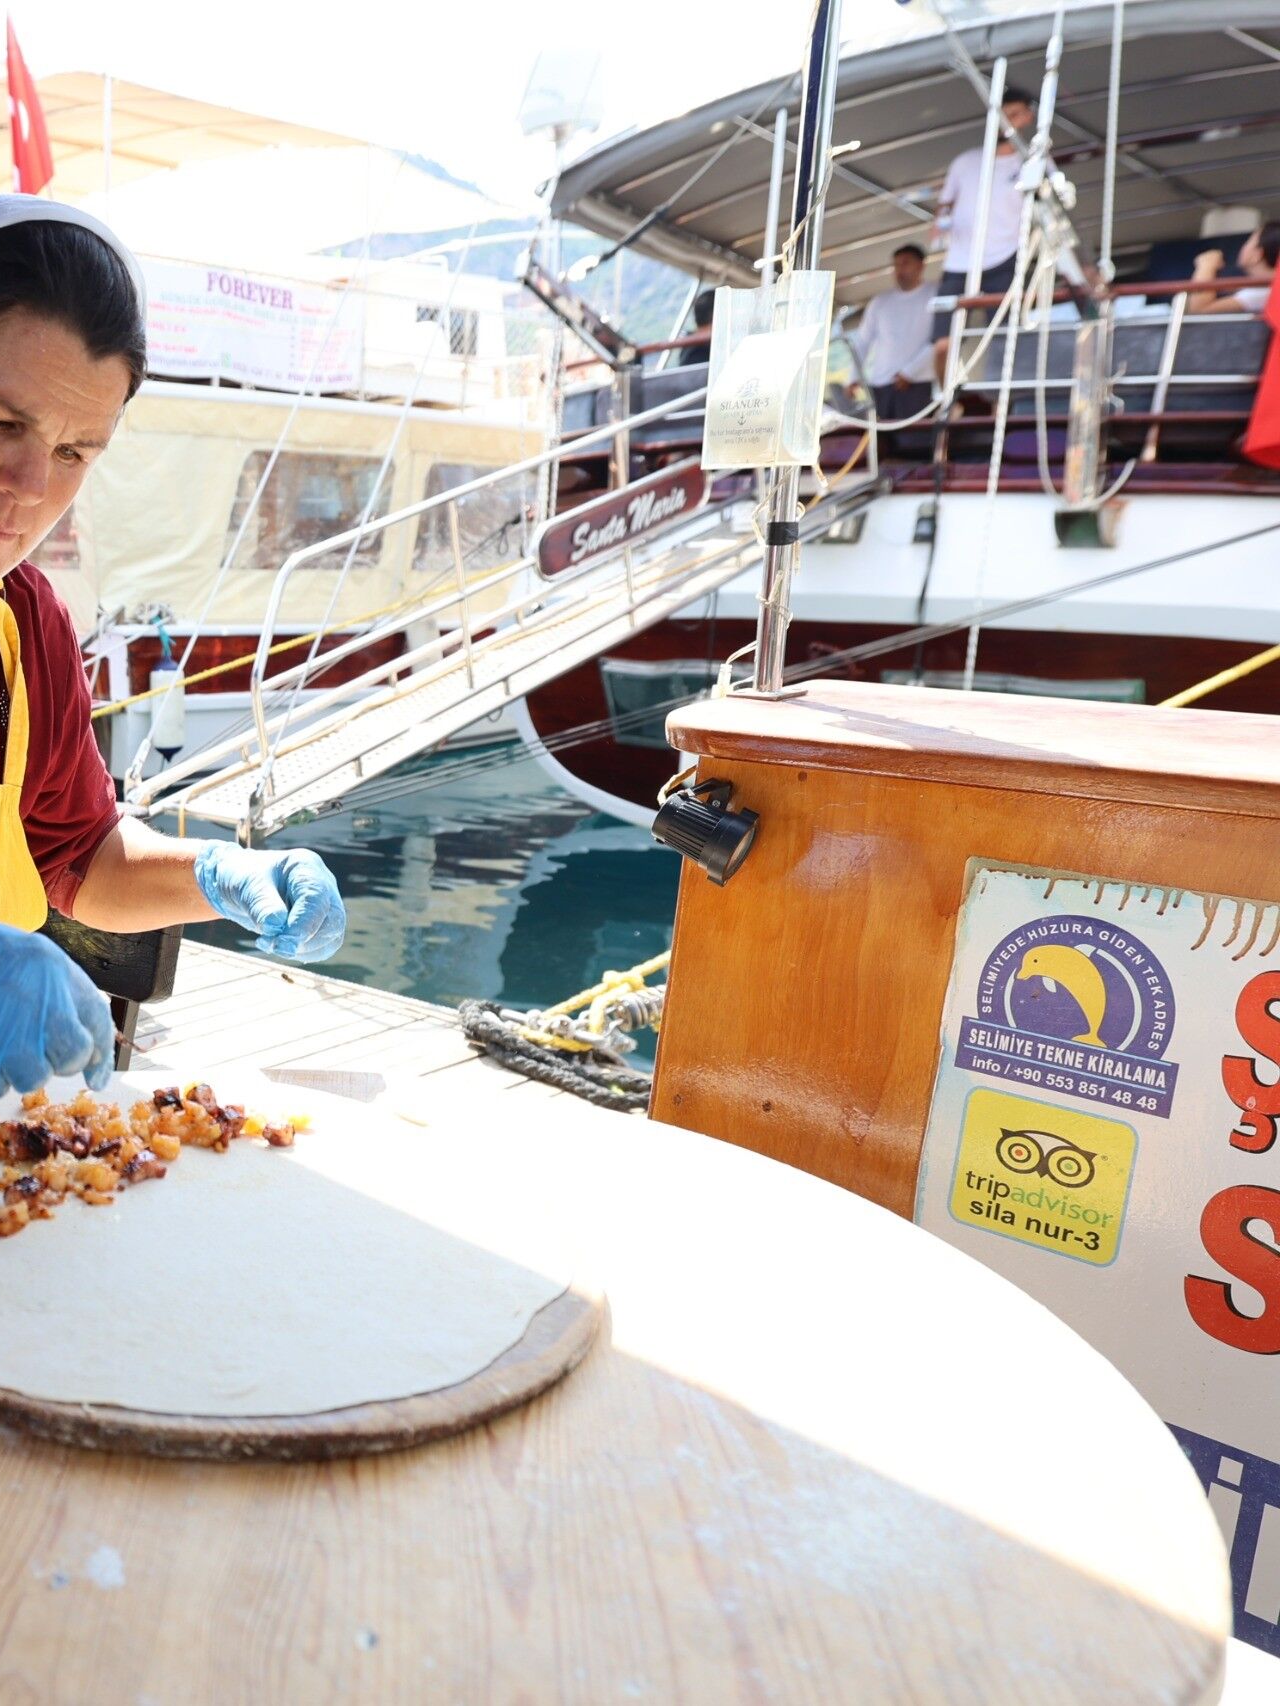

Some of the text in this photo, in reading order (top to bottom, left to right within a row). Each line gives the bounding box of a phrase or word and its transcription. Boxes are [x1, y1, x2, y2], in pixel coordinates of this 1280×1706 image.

[206, 271, 294, 310] FOREVER
[570, 486, 688, 563] Santa Maria
[982, 923, 1168, 1051] SELİMİYEDE HUZURA GİDEN TEK ADRES
[969, 1028, 1167, 1089] SELİMİYE TEKNE KİRALAMA
[972, 1055, 1158, 1111] info / +90 553 851 48 48
[965, 1170, 1114, 1229] tripadvisor
[969, 1198, 1101, 1251] sila nur-3
